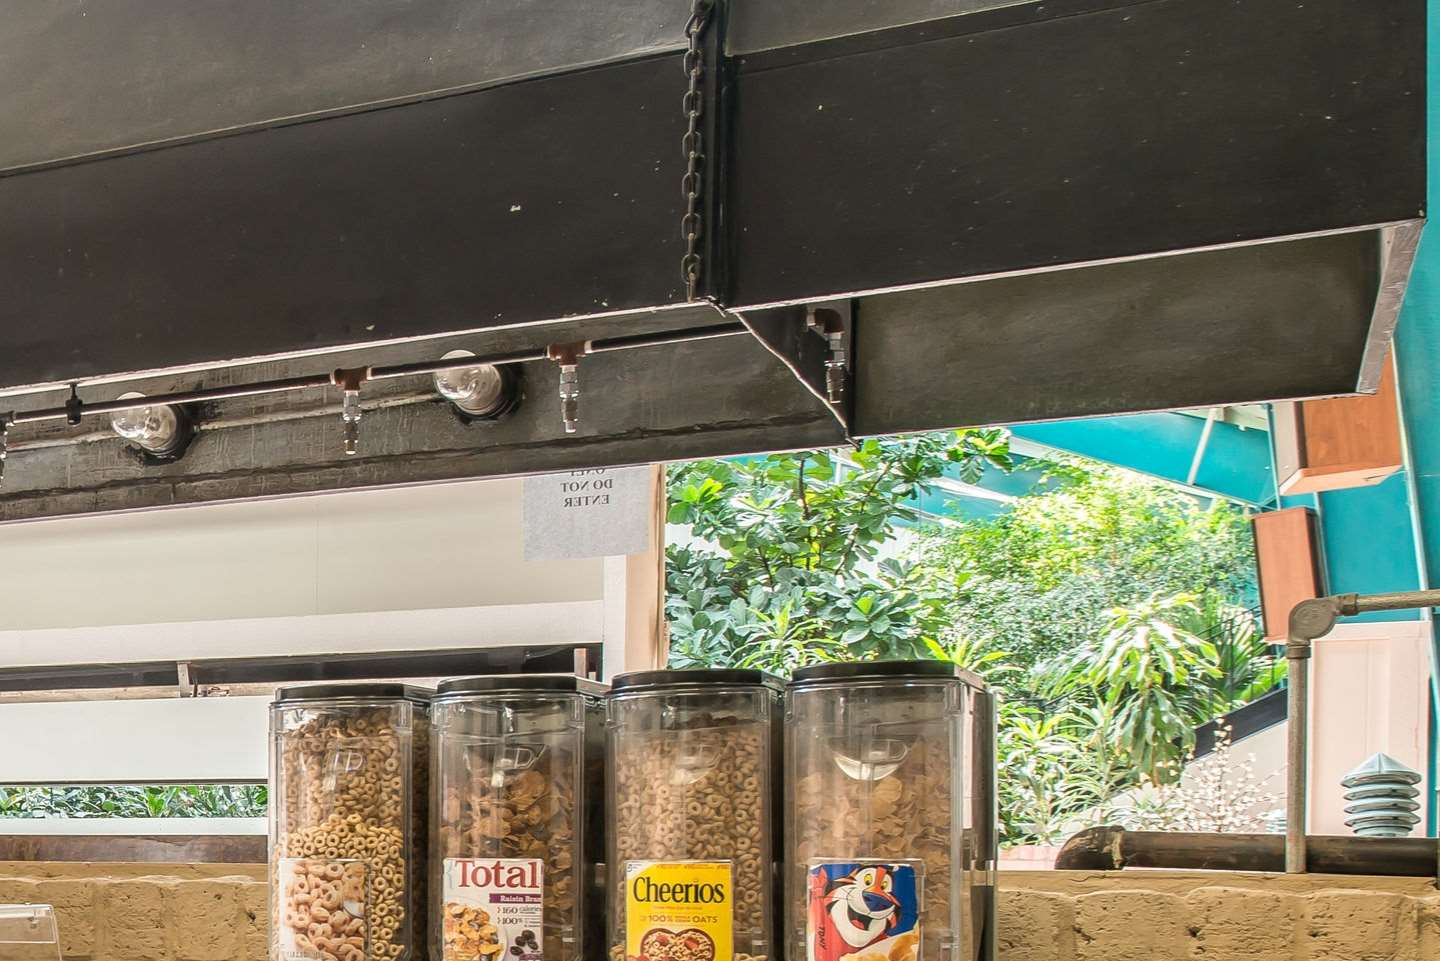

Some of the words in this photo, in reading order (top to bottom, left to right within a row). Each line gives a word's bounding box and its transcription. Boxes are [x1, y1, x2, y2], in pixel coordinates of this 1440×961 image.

[454, 859, 540, 889] Total
[633, 876, 726, 904] Cheerios
[692, 915, 719, 924] OATS
